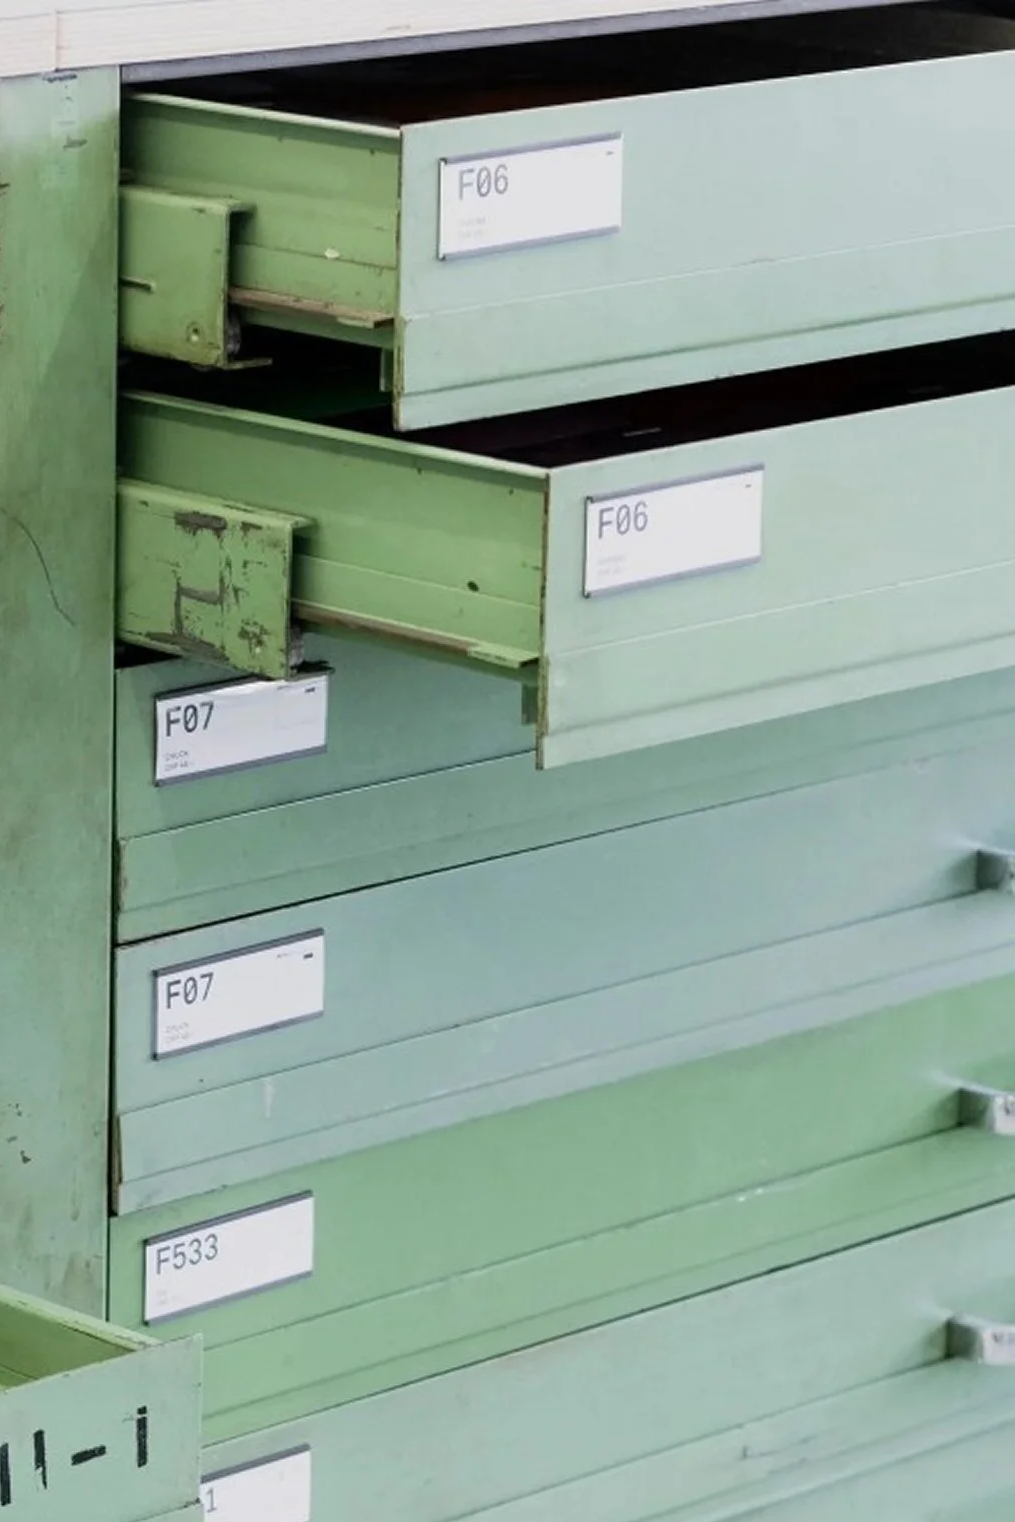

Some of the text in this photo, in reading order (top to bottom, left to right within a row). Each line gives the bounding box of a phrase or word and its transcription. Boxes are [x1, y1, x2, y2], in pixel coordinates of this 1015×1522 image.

[458, 163, 509, 201] F06
[597, 500, 649, 540] F06
[165, 701, 215, 737] F07
[165, 971, 214, 1009] F07
[155, 1233, 219, 1275] F533
